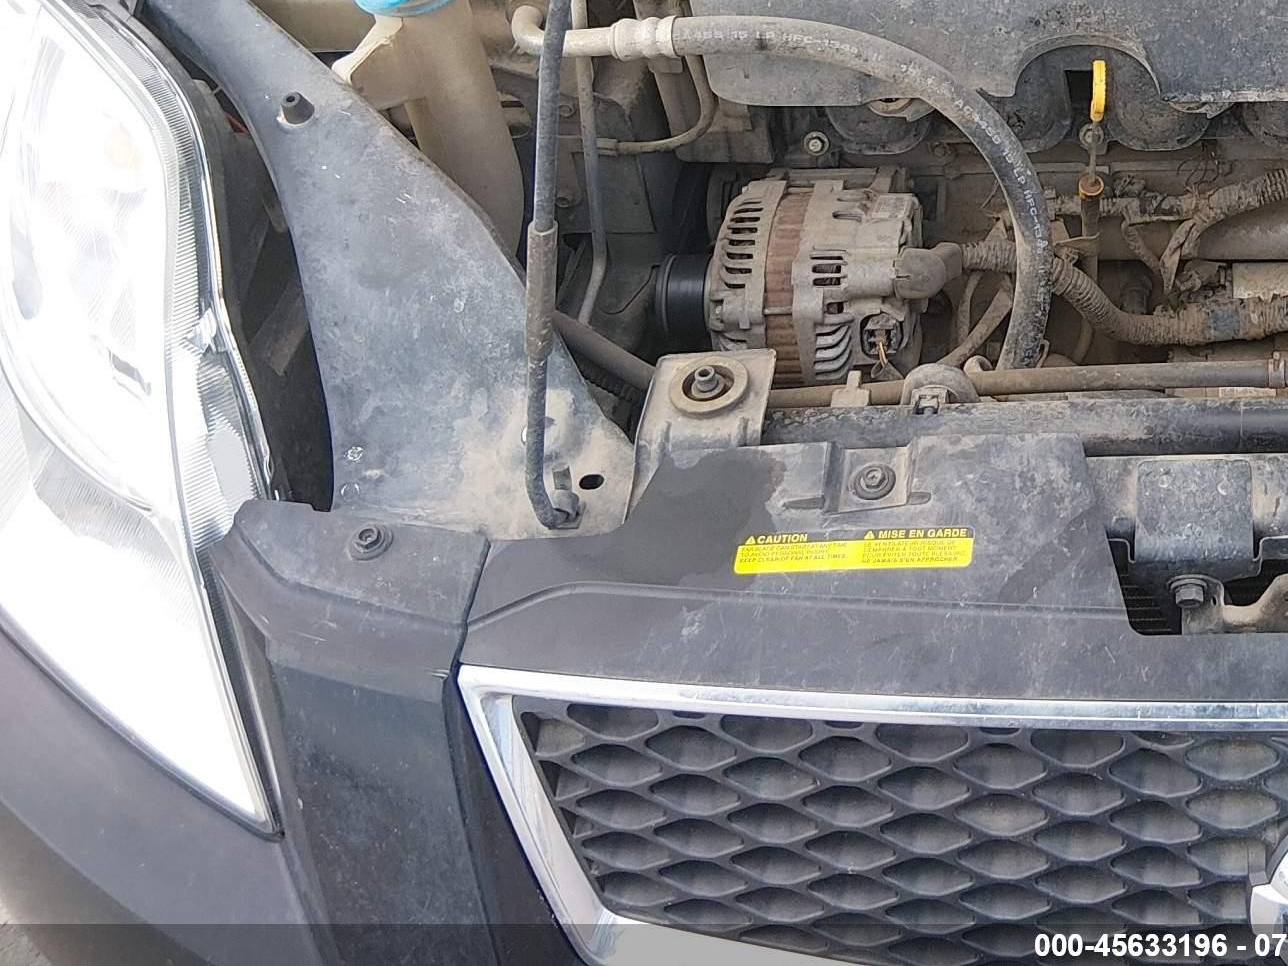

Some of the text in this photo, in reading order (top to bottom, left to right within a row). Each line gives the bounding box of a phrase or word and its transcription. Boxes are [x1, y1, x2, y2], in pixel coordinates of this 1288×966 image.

[878, 528, 967, 539] MISE EN GARDE
[757, 534, 808, 544] CAUTION
